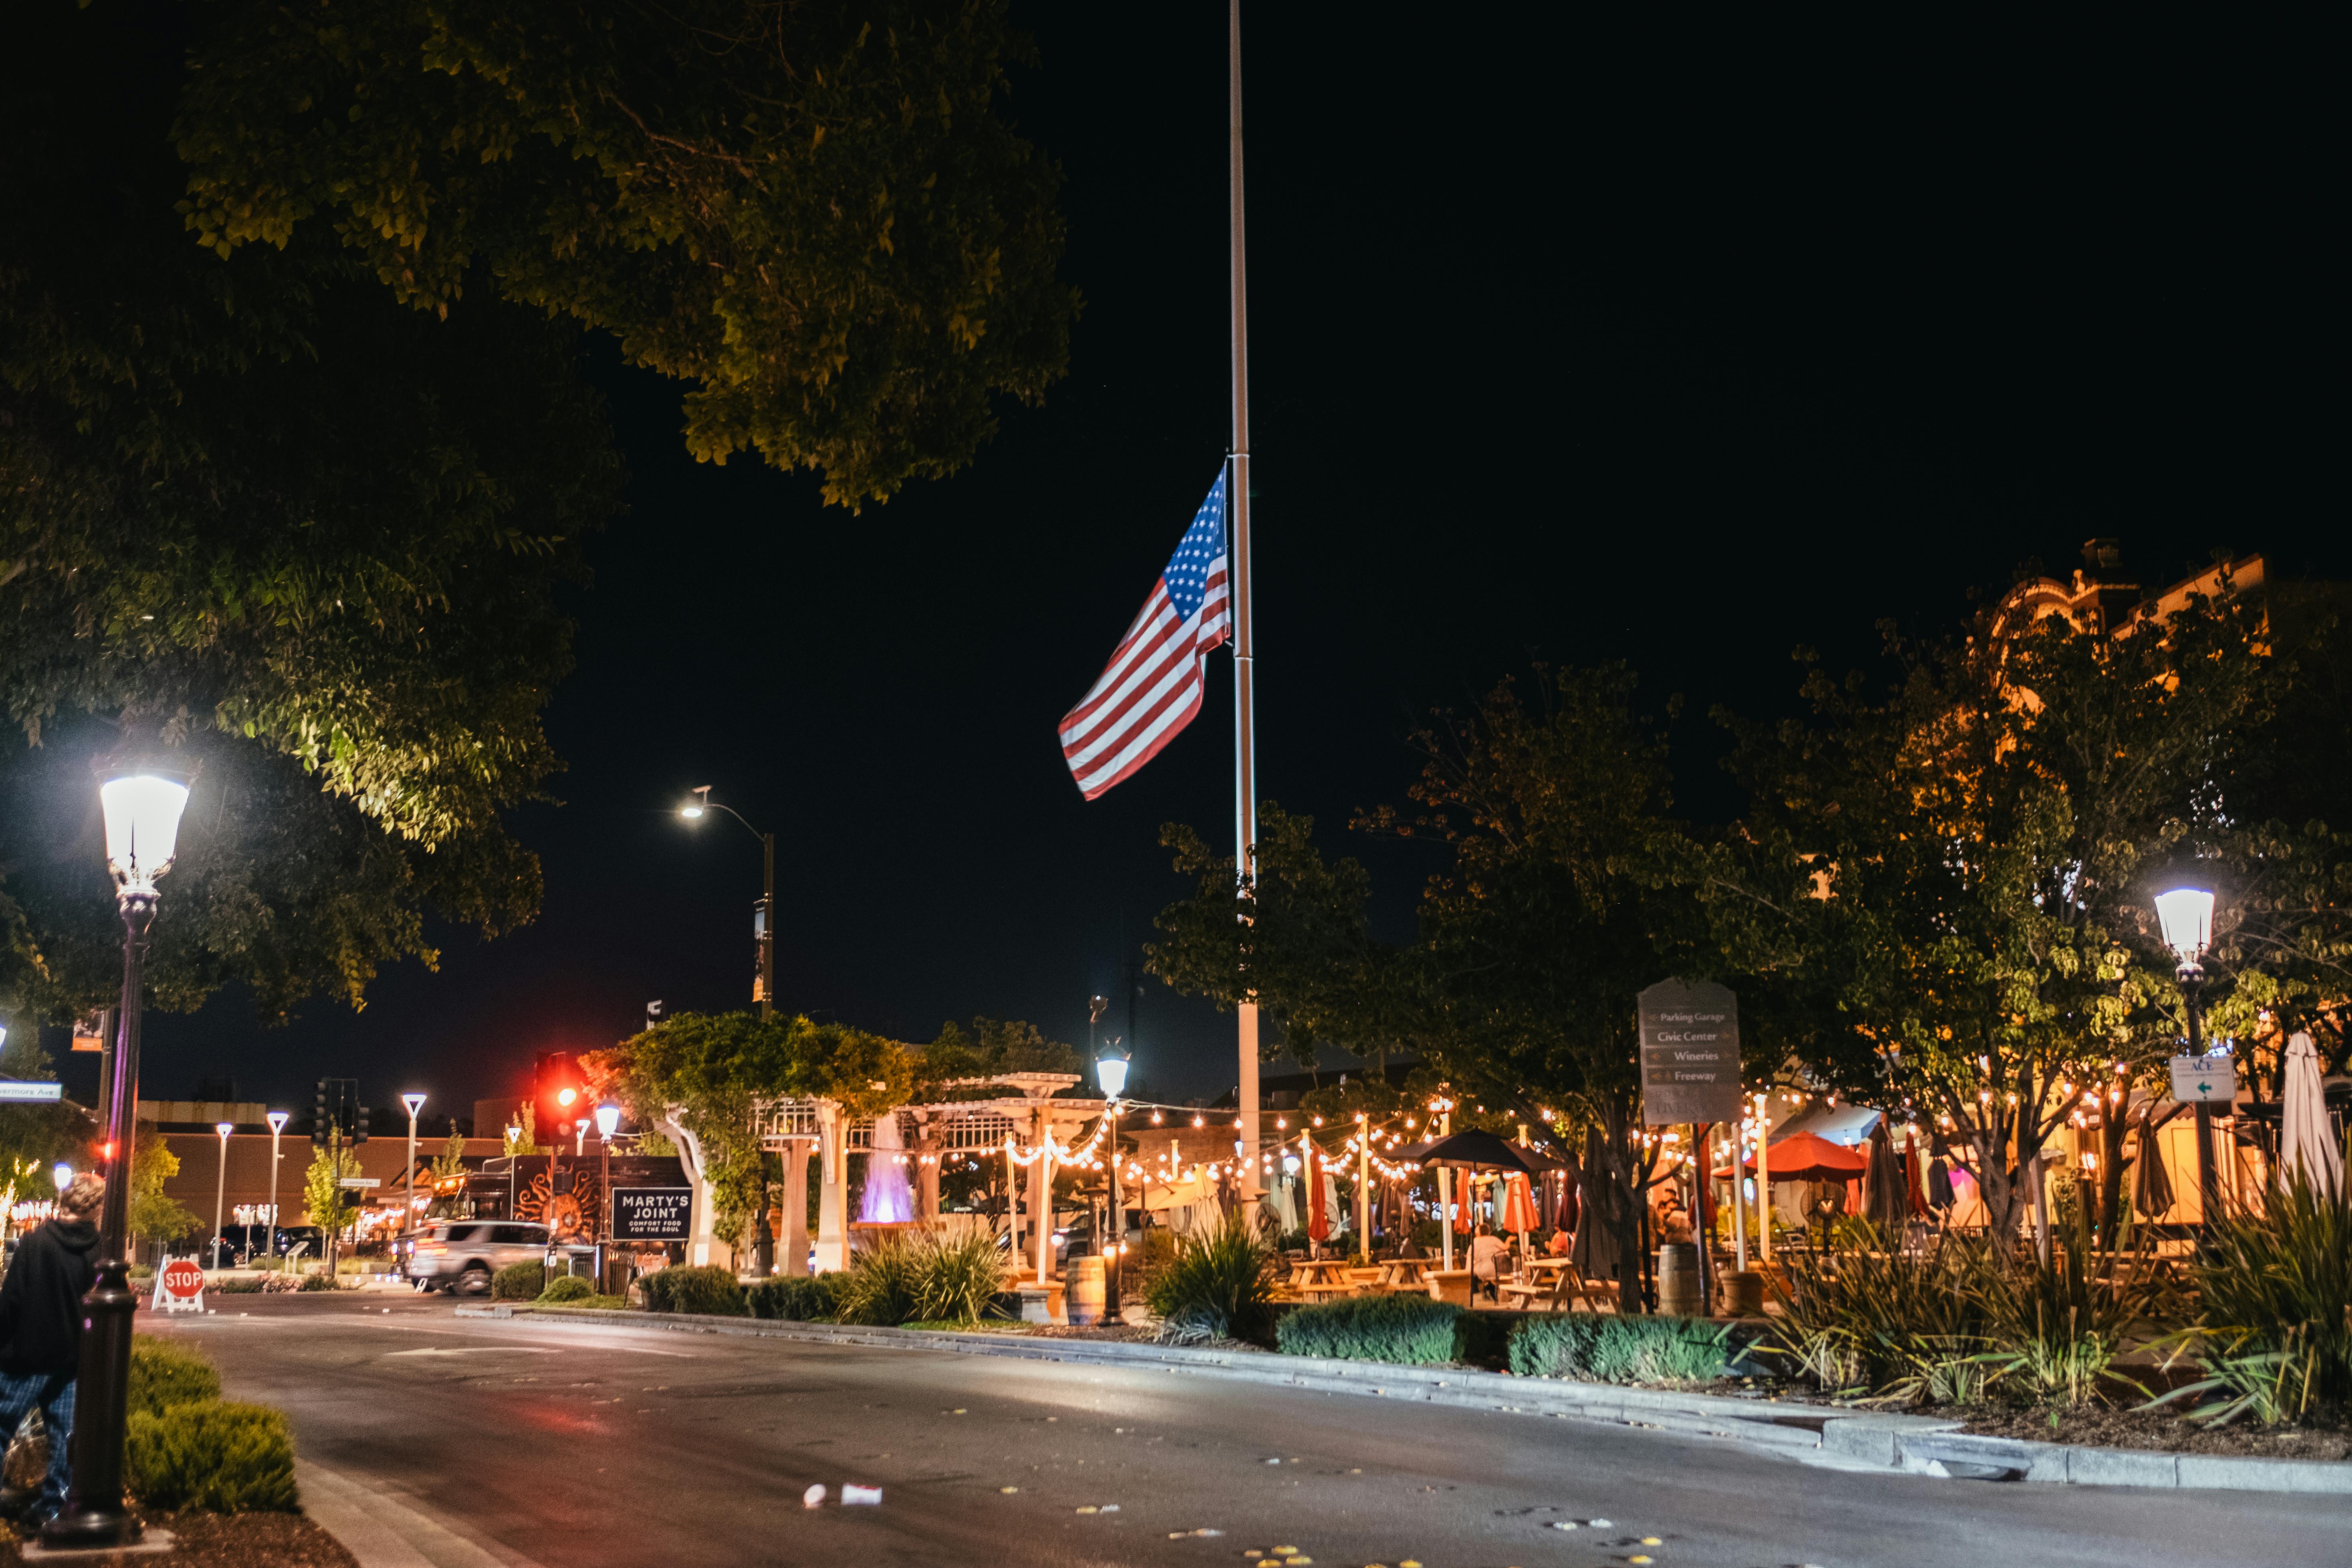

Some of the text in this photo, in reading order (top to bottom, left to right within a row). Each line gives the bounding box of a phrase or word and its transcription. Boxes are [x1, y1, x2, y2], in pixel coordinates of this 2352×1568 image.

[1661, 1013, 1724, 1023] Parking Garage
[1658, 1031, 1717, 1041] Civic Center
[1674, 1051, 1718, 1061] Wineries
[2190, 1061, 2213, 1071] ACE
[1674, 1071, 1716, 1083] Freeway
[622, 1196, 688, 1207] MARTY'S
[633, 1208, 678, 1219] JOINT
[166, 1272, 202, 1287] STOP
